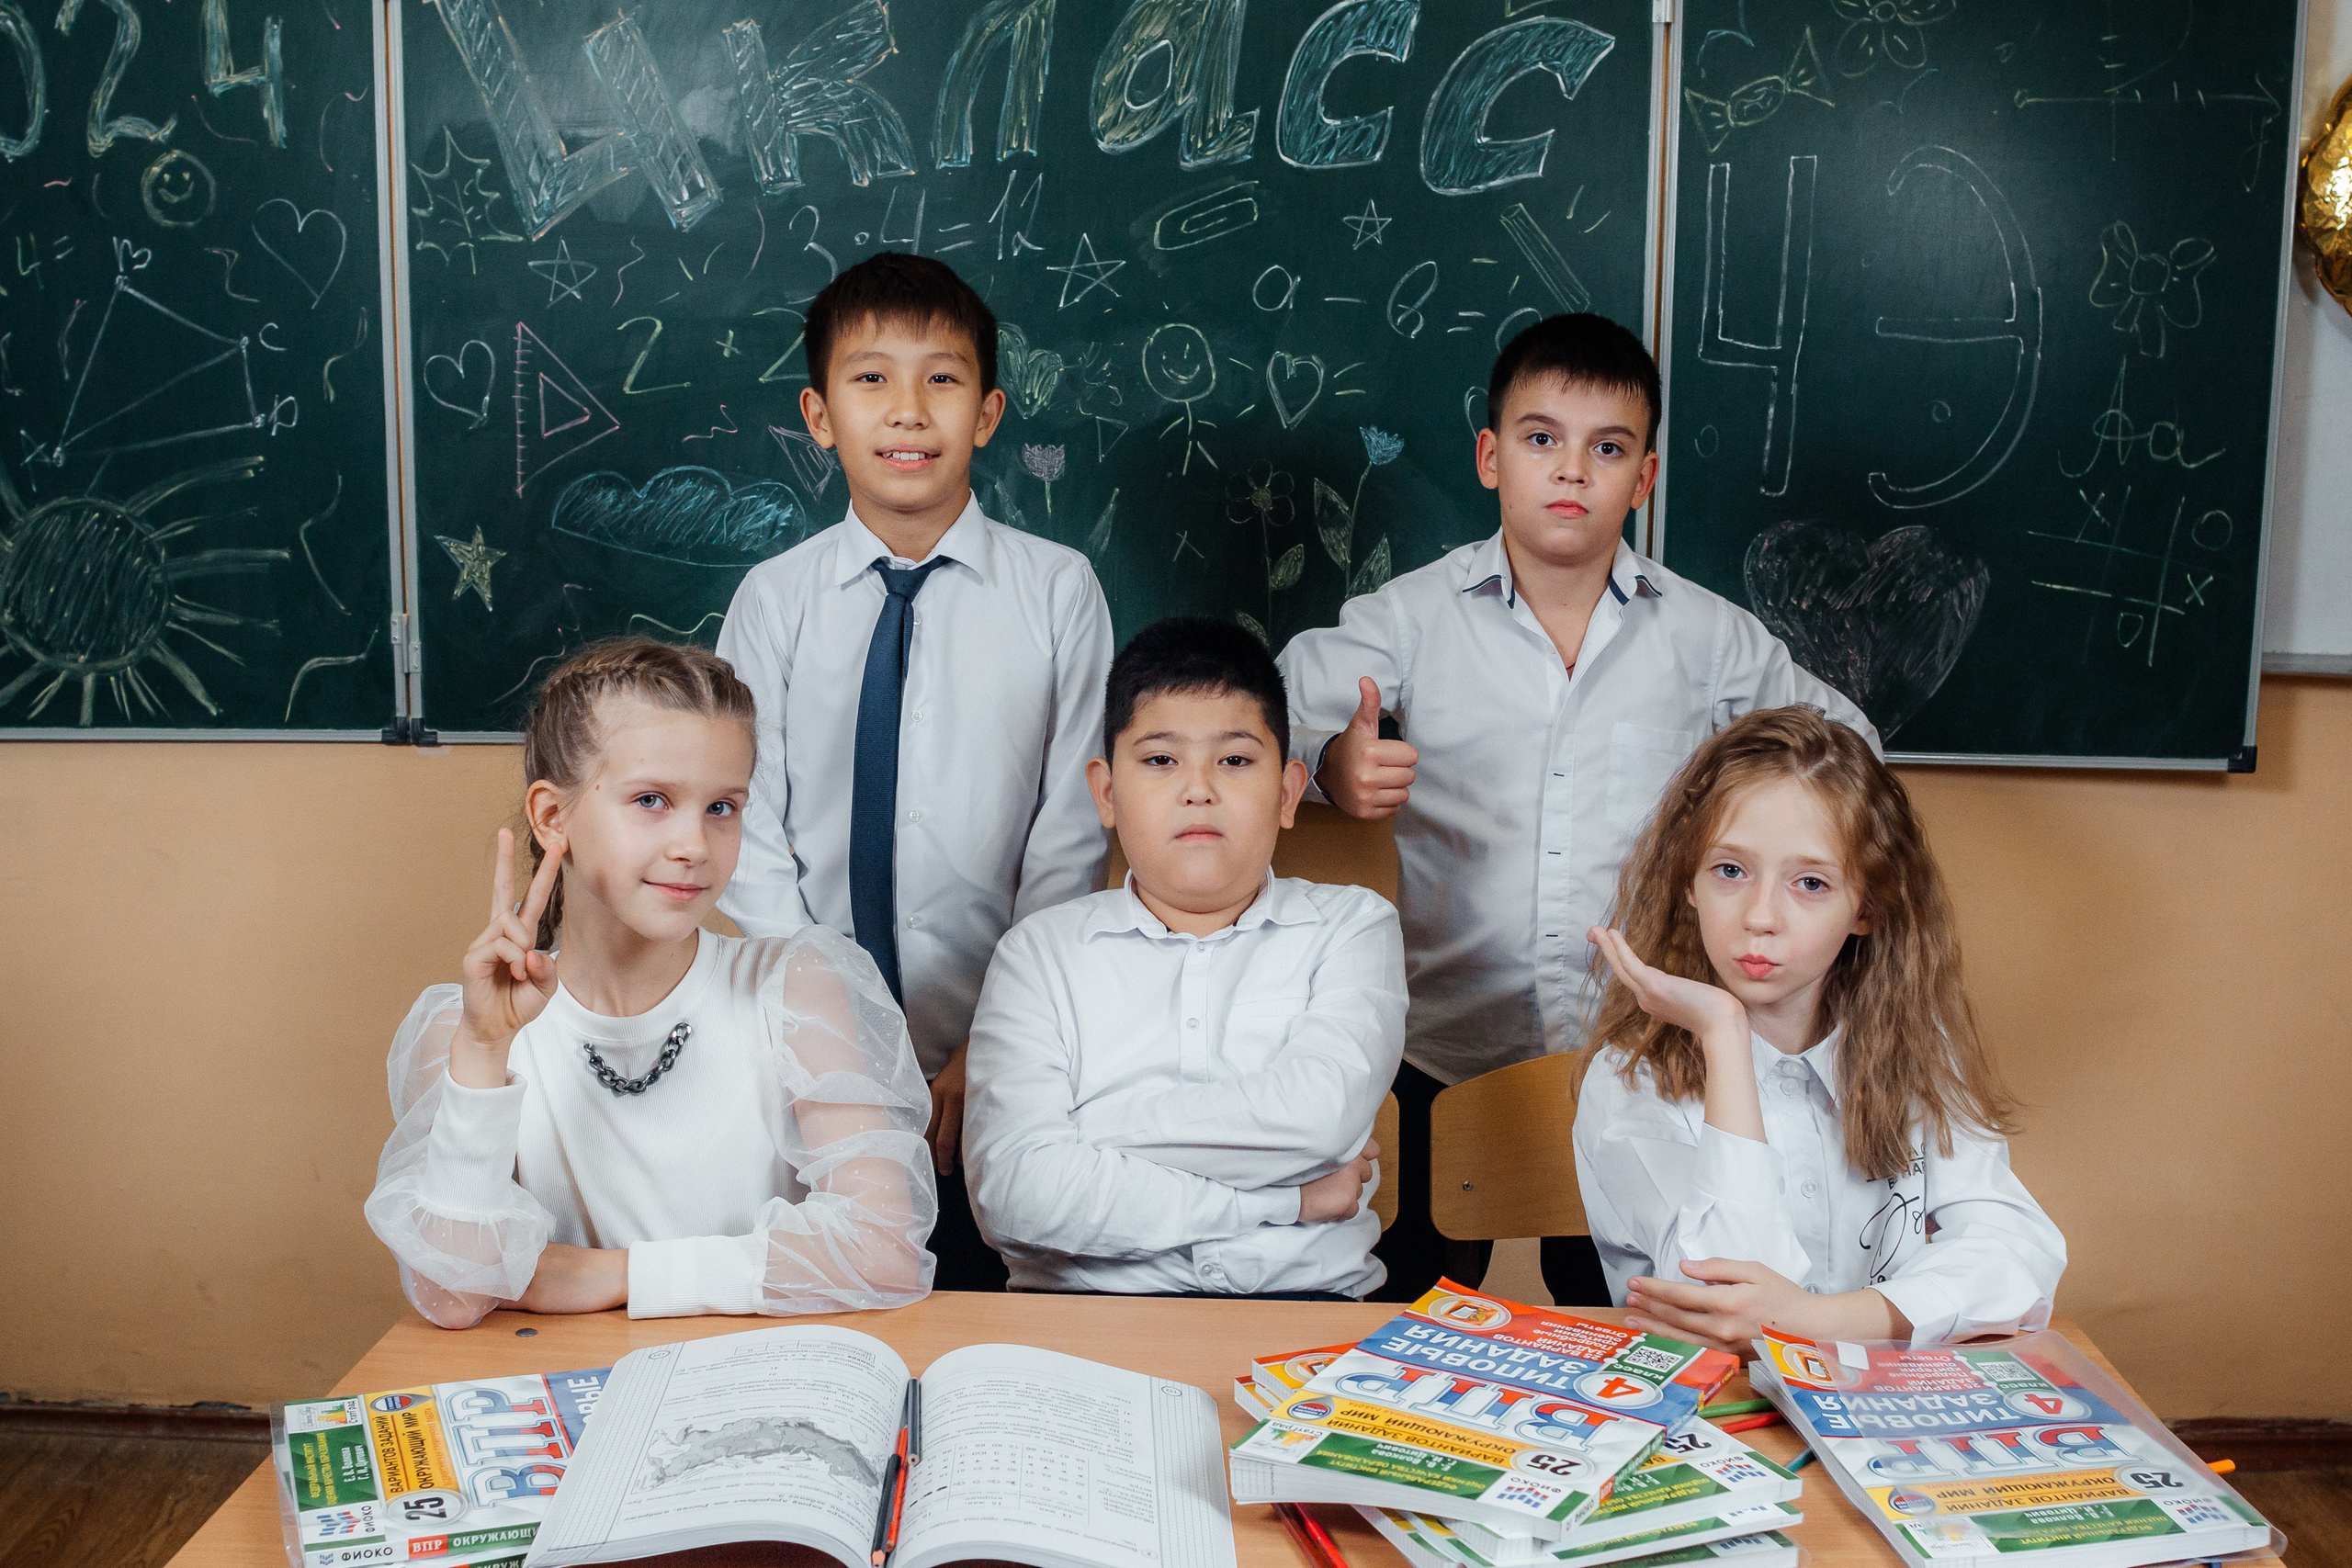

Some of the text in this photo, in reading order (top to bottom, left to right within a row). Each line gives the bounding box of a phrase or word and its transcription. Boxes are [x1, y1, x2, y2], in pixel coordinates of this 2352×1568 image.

[1532, 1328, 1614, 1351] Подробные
[1541, 1320, 1623, 1343] оценивания
[1576, 1322, 1629, 1339] Ответы
[1404, 1324, 1589, 1374] ЗАДАНИЯ
[1493, 1333, 1582, 1358] ВАРИАНТОВ
[1536, 1337, 1607, 1356] ЗАДАНИЙ
[1380, 1335, 1570, 1390] ТИПОВЫЕ
[1612, 1363, 1666, 1381] класс
[1597, 1376, 1645, 1400] 4
[1335, 1362, 1626, 1454] ВПР
[1812, 1392, 1998, 1412] ЗАДАНИЯ
[2023, 1393, 2064, 1415] 4
[1340, 1408, 1381, 1422] МИР
[1822, 1406, 2022, 1430] ТИПОВЫЕ
[372, 1415, 394, 1447] ЗАДАНИЙ
[1272, 1420, 1323, 1437] СтатГрад
[1385, 1416, 1517, 1455] ОКРУЖАЮЩИЙ
[401, 1412, 435, 1489] ОКРУЖАЮЩИЙ МИР
[1326, 1418, 1583, 1477] 25 ВАРИАНТОВ ЗАДАНИЙ
[1371, 1448, 1423, 1465] Волкова
[1375, 1442, 1428, 1459] Цитович
[1867, 1424, 2144, 1479] ВПР
[381, 1448, 404, 1493] ВАРИАНТОВ
[1700, 1454, 1746, 1469] ФИОКО
[1510, 1475, 1563, 1494] ФИОКО
[1983, 1475, 2117, 1496] ОКРУЖАЮЩИЙ
[2130, 1471, 2185, 1489] 25
[1936, 1488, 1977, 1499] МИР
[2031, 1488, 2131, 1505] ВАРИАНТОВ
[403, 1496, 448, 1521] 25
[1946, 1498, 2027, 1512] ЗАДАНИЙ
[341, 1546, 393, 1562] ФИОКО
[413, 1539, 443, 1553] ВПР
